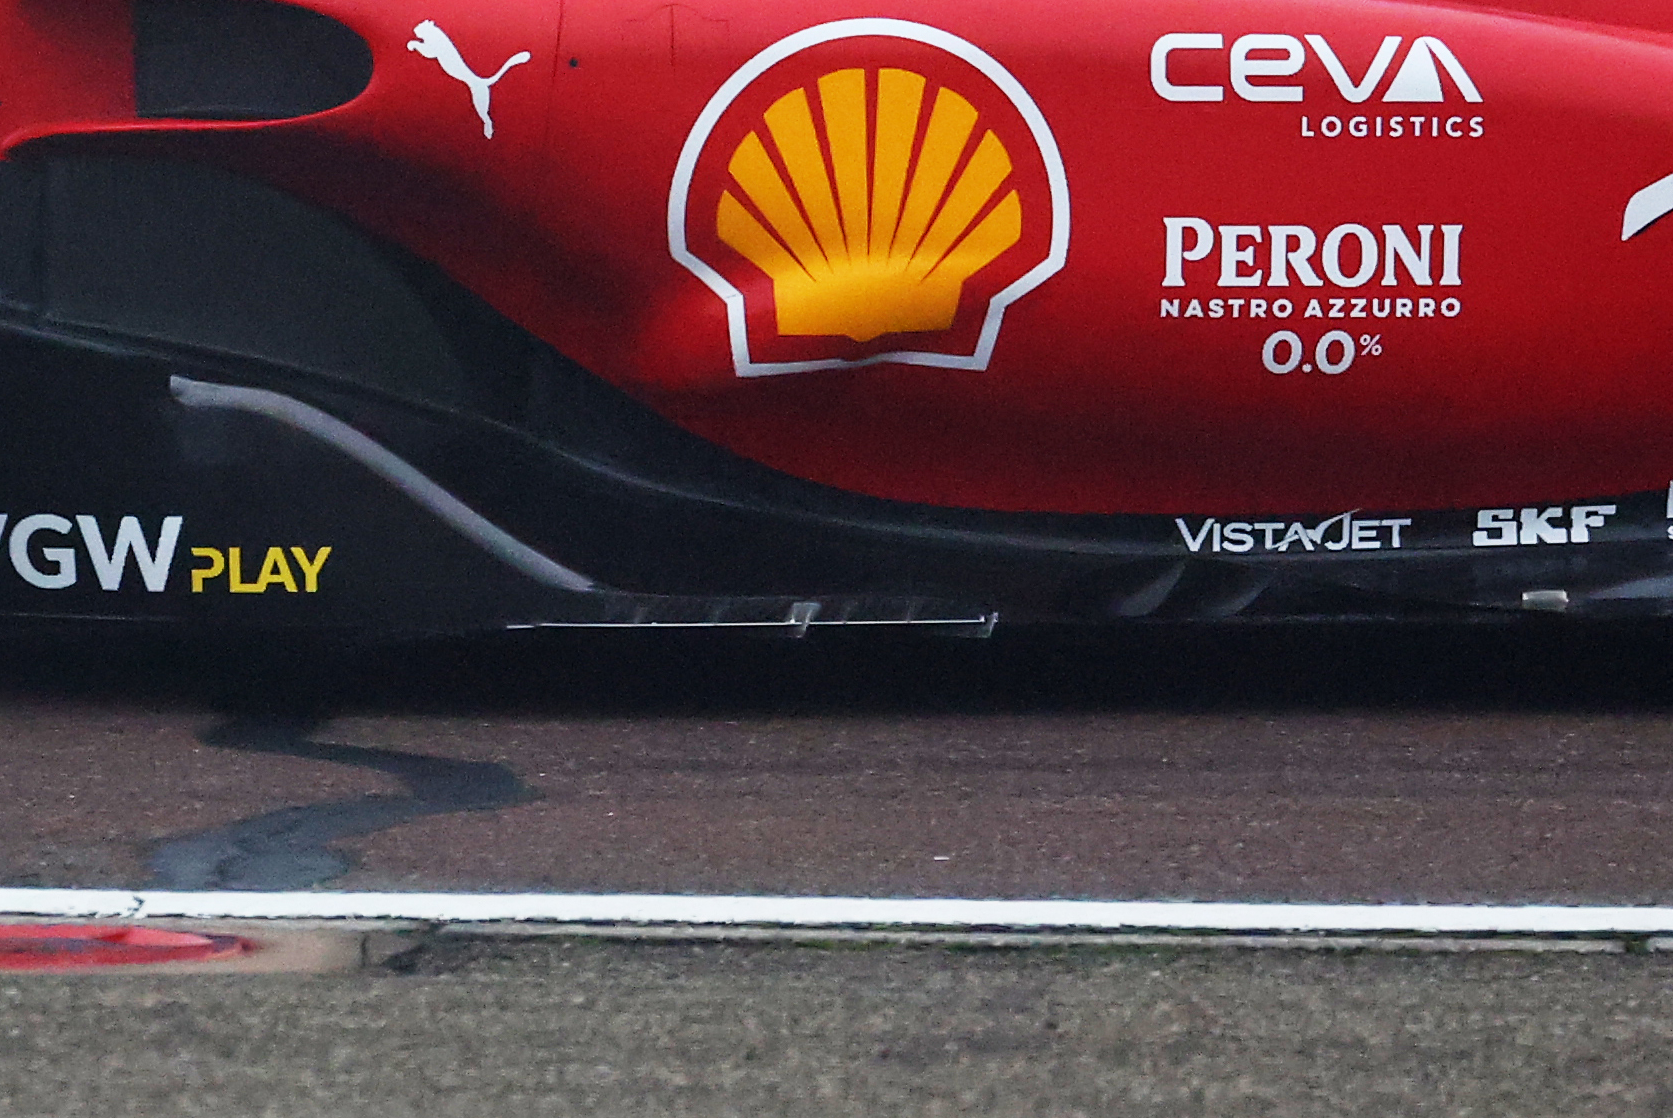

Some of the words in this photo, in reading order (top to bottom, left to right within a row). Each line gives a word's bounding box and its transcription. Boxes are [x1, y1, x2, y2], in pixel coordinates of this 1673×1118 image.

[1302, 116, 1484, 138] LOGISTICS
[1161, 216, 1464, 287] PERONI
[1160, 298, 1293, 318] NASTRO
[1304, 297, 1462, 318] AZZURRO
[1261, 330, 1383, 374] 0.0%
[1472, 505, 1616, 547] SKF
[191, 546, 332, 593] PLAY
